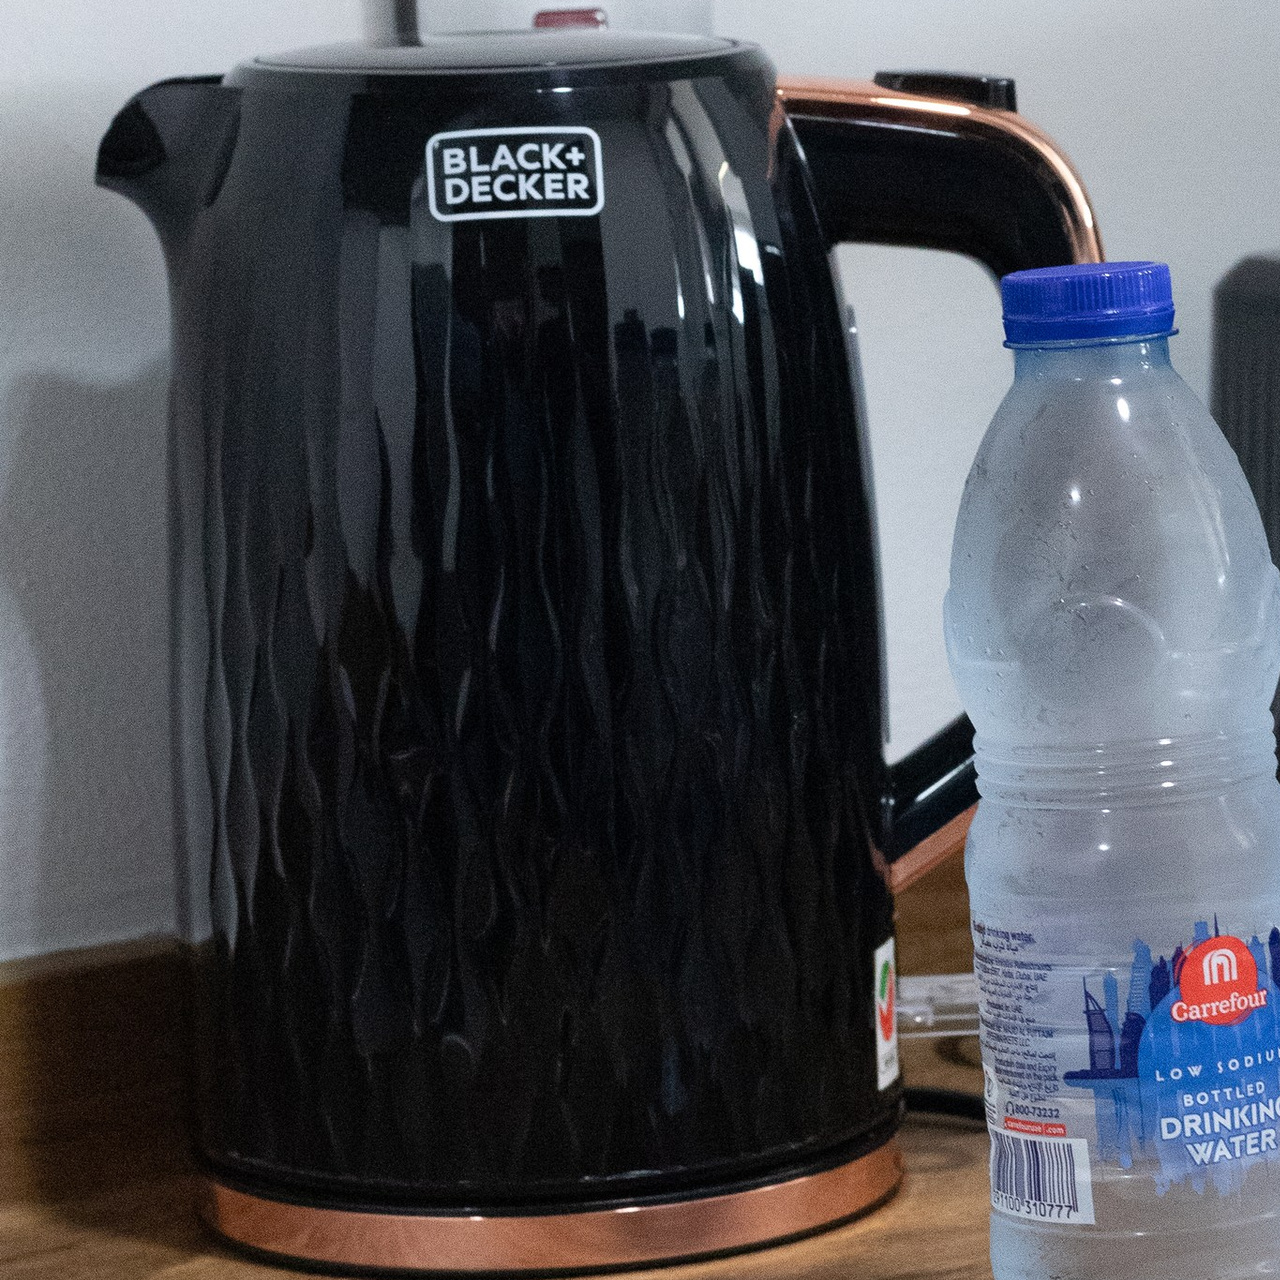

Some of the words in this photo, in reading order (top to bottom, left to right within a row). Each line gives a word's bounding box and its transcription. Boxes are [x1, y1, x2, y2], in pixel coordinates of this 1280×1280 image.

[443, 143, 586, 175] BLACK+
[444, 172, 590, 204] DECKER
[1171, 989, 1268, 1022] Carrefour
[1155, 1065, 1203, 1083] LOW
[1183, 1080, 1265, 1108] BOTTLED
[1185, 1128, 1278, 1167] WATER
[1024, 1200, 1074, 1219] 310777
